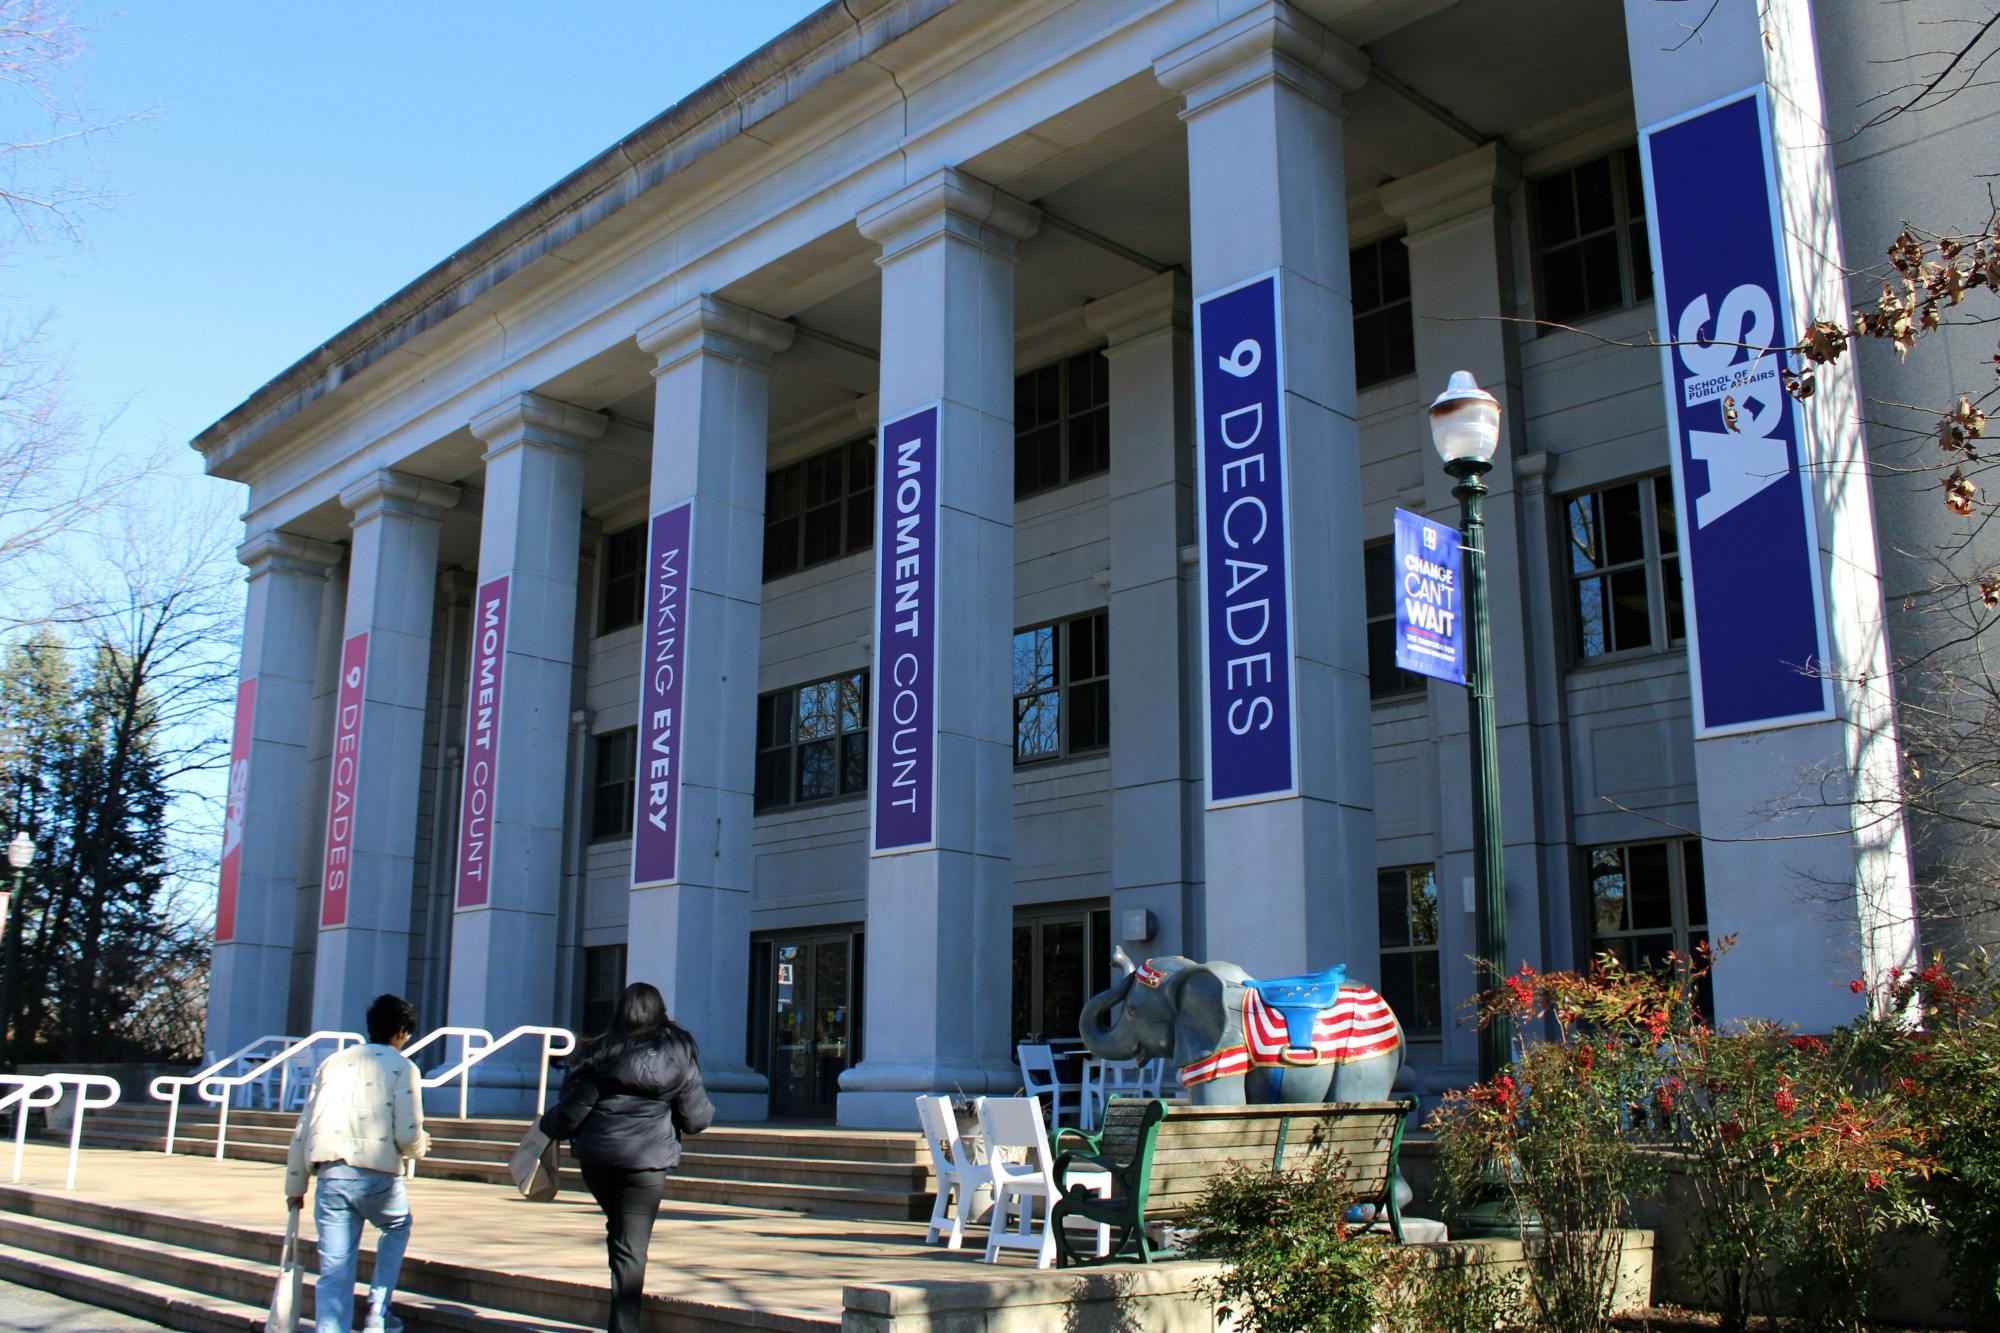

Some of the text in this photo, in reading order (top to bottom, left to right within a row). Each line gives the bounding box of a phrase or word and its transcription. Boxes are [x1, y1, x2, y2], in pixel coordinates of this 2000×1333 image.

[1678, 283, 1790, 530] SPA
[1688, 369, 1749, 393] SCHOOL OF
[1688, 383, 1727, 400] PUBLIC
[891, 437, 922, 813] MOMENT COUNT
[1219, 338, 1274, 736] 9 DECADES
[1405, 554, 1453, 584] CHANGE
[1405, 598, 1455, 637] WAIT
[328, 666, 361, 891] 9 DECADES
[466, 598, 500, 882] MOMENT COUNT
[648, 548, 680, 832] MAKING EVERY
